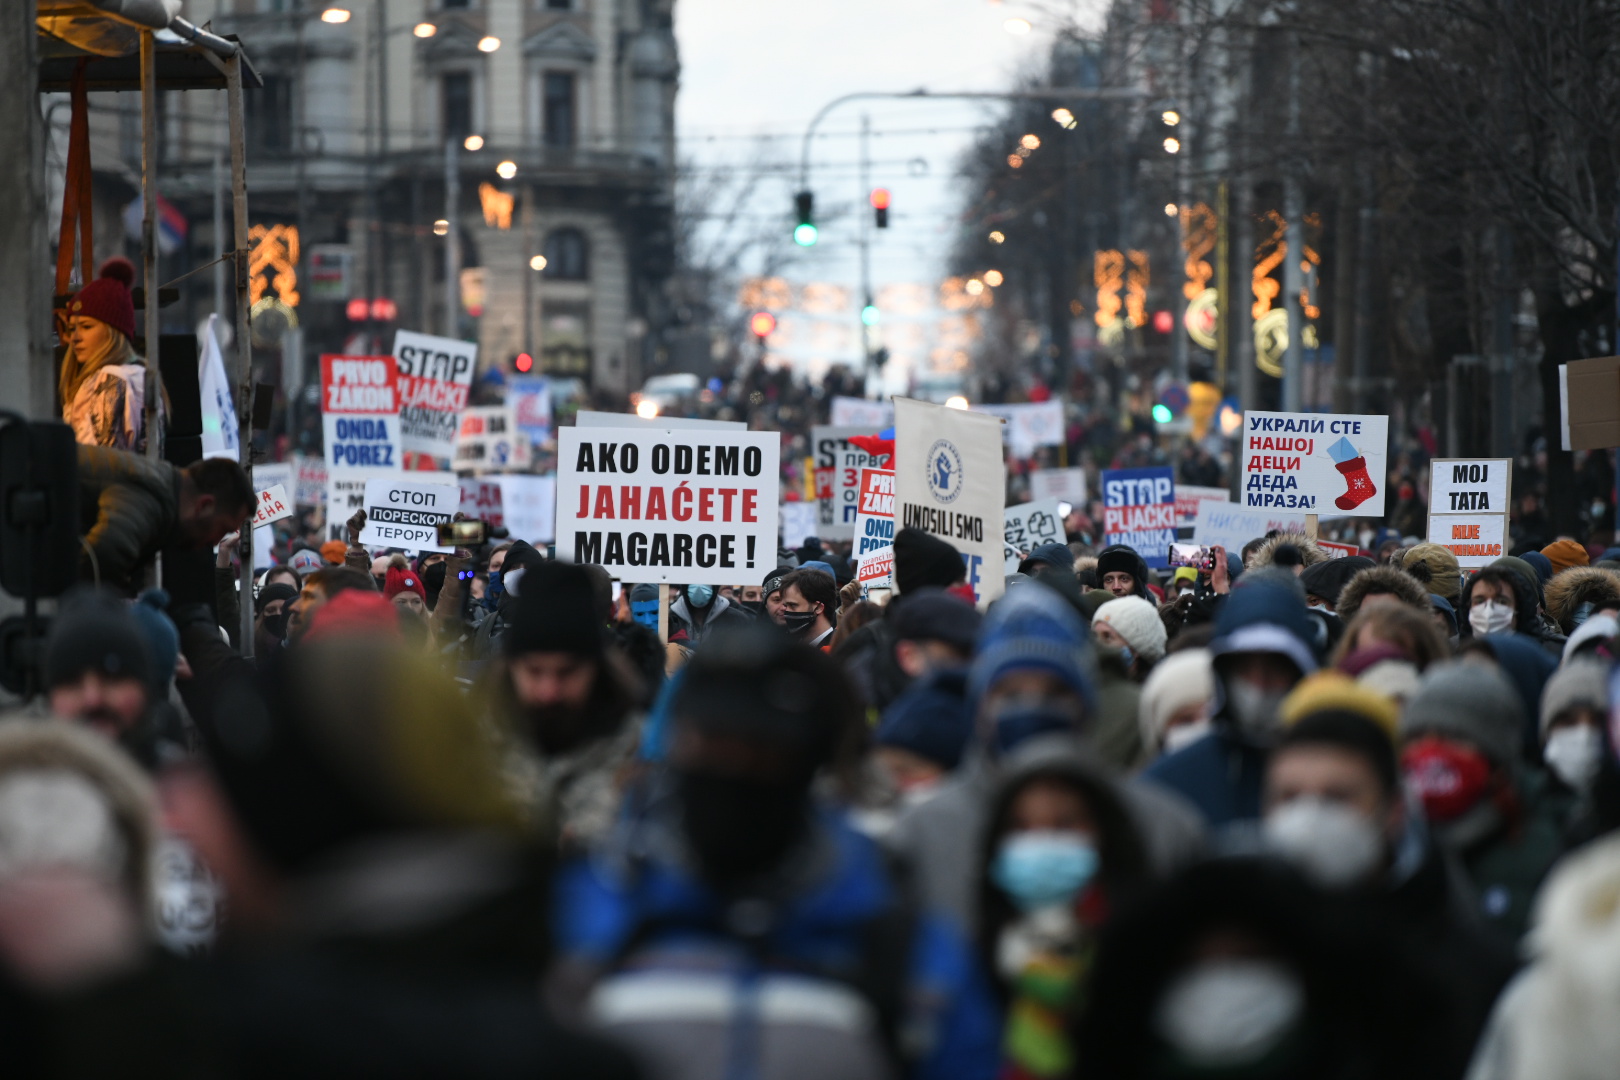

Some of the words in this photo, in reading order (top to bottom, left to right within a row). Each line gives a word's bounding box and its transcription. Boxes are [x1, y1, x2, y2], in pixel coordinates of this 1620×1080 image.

[331, 359, 387, 385] PRVO
[399, 346, 468, 382] STOP
[328, 385, 393, 411] ZAKON
[400, 404, 456, 431] ADNIKA
[1249, 417, 1325, 433] УКРАЛИ
[1330, 420, 1361, 435] СТЕ
[336, 418, 388, 440] ONDA
[333, 444, 393, 466] POREZ
[1249, 436, 1314, 455] НАШОЈ
[576, 442, 638, 473] AKO
[651, 444, 762, 476] ODEMO
[1247, 455, 1301, 473] ДЕЦИ
[1247, 474, 1298, 492] ДЕДА
[1453, 464, 1488, 483] MOJ
[389, 489, 436, 506] СТОП
[576, 481, 757, 522] JAHAĆETE
[1107, 477, 1171, 507] STOP
[1247, 493, 1316, 509] МРАЗА!
[1449, 491, 1489, 510] TATA
[373, 508, 447, 526] ПОРЕСКОМ
[865, 517, 894, 538] OND
[903, 503, 954, 536] UNOSILI
[956, 514, 983, 543] SMO
[376, 526, 434, 542] ТЕРОРУ
[1452, 525, 1480, 539] NIJE
[574, 531, 735, 568] MAGARCE
[746, 535, 756, 568] !
